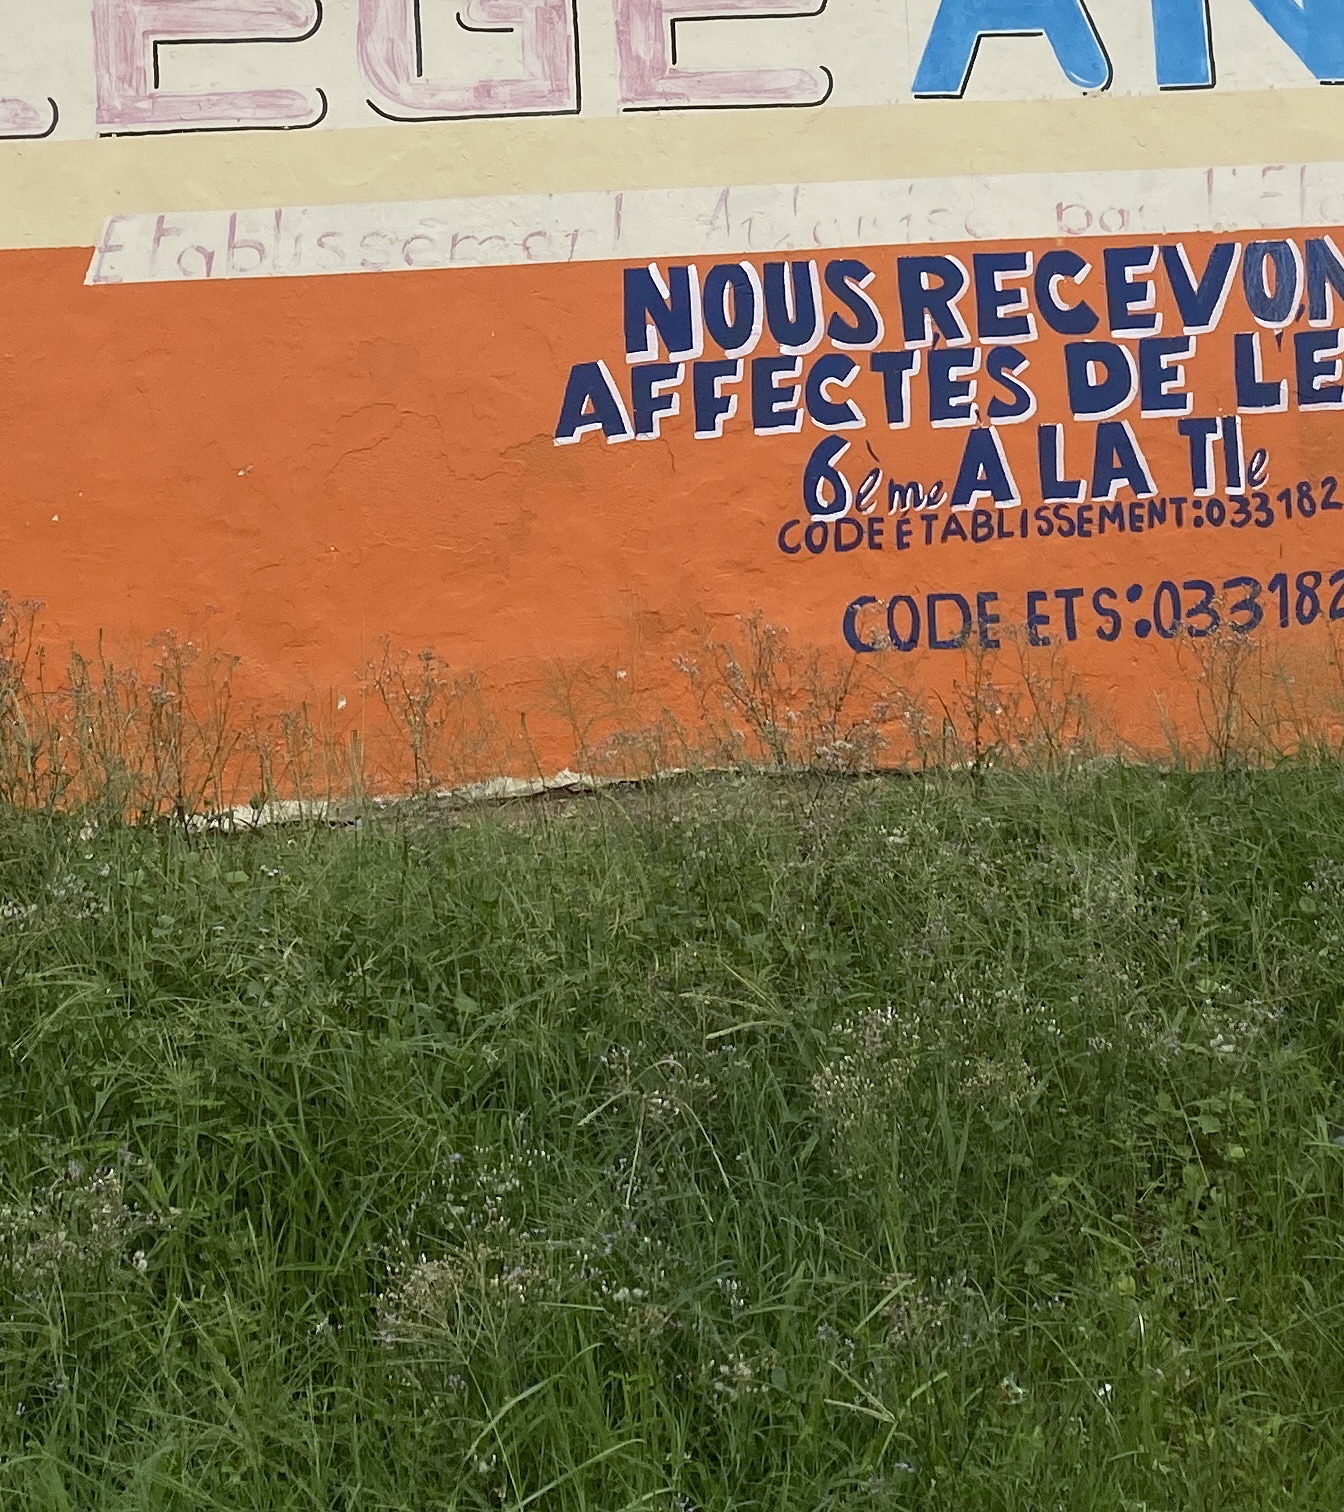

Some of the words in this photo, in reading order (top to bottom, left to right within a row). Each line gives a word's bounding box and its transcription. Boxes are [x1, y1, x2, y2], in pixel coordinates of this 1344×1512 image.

[623, 258, 885, 364] NOUS
[1064, 335, 1195, 420] DE
[1038, 422, 1159, 506] LA
[778, 515, 884, 555] CODE
[842, 591, 1001, 653] CODE
